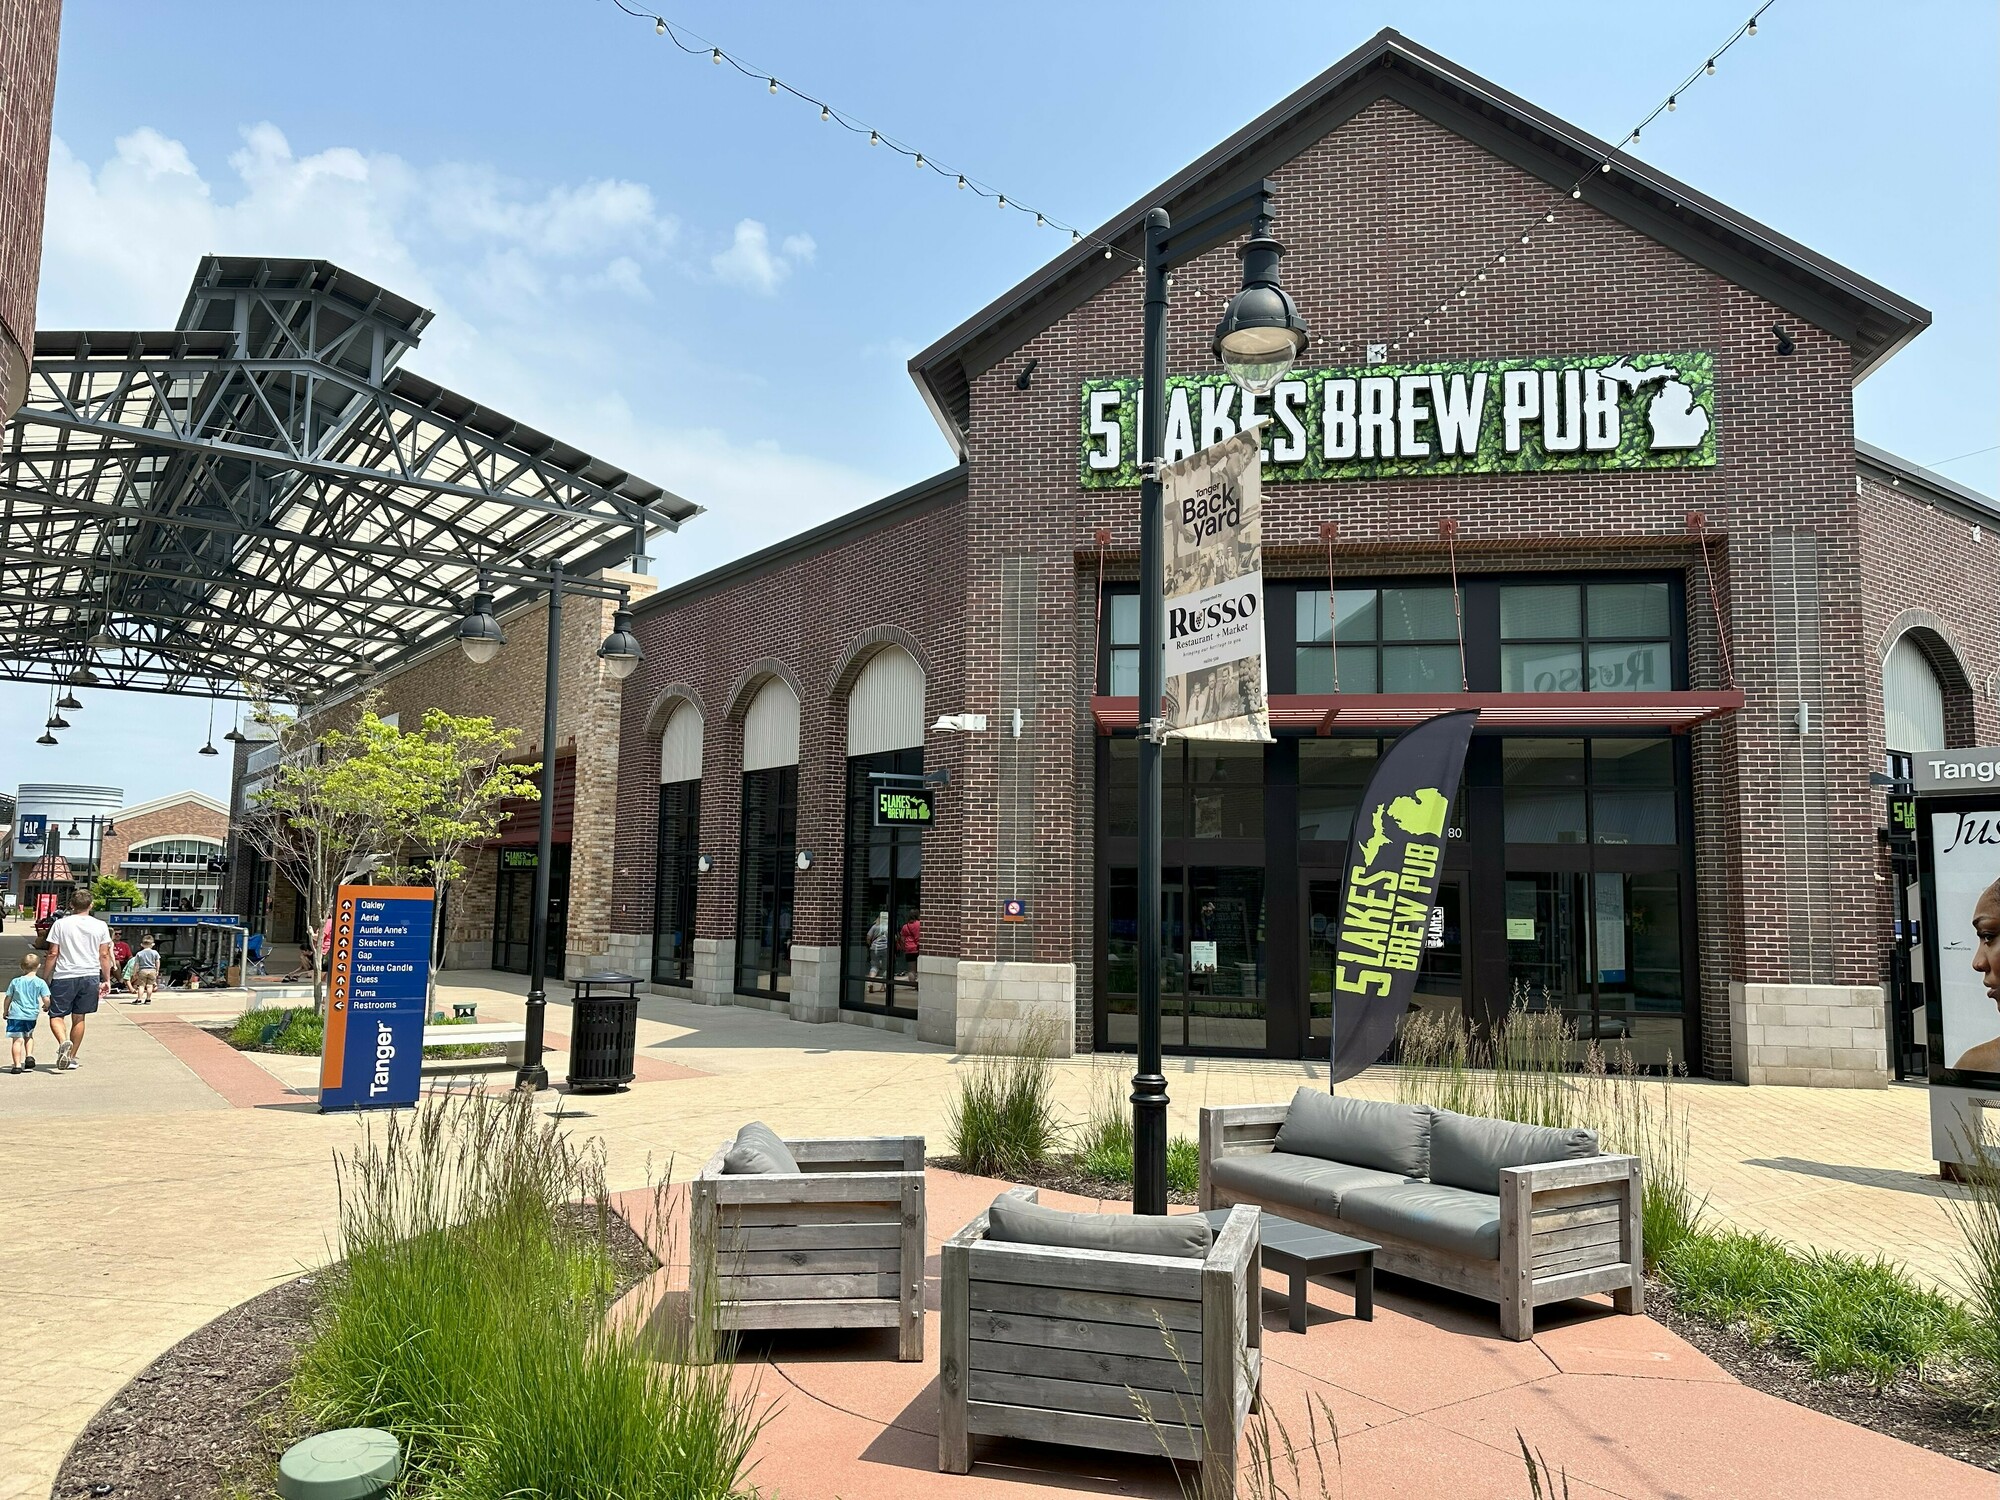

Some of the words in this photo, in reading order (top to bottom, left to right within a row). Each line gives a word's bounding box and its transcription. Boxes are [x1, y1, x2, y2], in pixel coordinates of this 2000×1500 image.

[1089, 389, 1121, 470] 5
[1323, 372, 1488, 459] BREW
[1504, 368, 1620, 451] PUB
[1196, 483, 1220, 498] Tanger
[1183, 483, 1235, 525] Back
[1193, 498, 1239, 546] yard
[1176, 633, 1213, 649] Restaurant
[1222, 623, 1249, 637] Market
[881, 794, 887, 812] 5
[888, 794, 910, 809] LAKES
[888, 808, 905, 819] BREW
[906, 808, 917, 819] PUB
[1894, 802, 1903, 821] 5
[24, 821, 38, 834] GAP
[1448, 827, 1462, 839] 80
[505, 851, 510, 862] 5
[1399, 842, 1440, 894] PUB
[361, 901, 385, 910] Oakley
[1338, 865, 1399, 967] LAKES
[360, 926, 382, 934] Auntie
[384, 926, 407, 934] Anne's
[1385, 896, 1429, 971] BREW
[358, 939, 395, 947] Skechers
[358, 951, 372, 960] Gap
[356, 975, 378, 983] Guess
[1336, 965, 1392, 997] 5
[354, 1001, 397, 1009] Restrooms
[370, 1022, 395, 1097] Tanger
